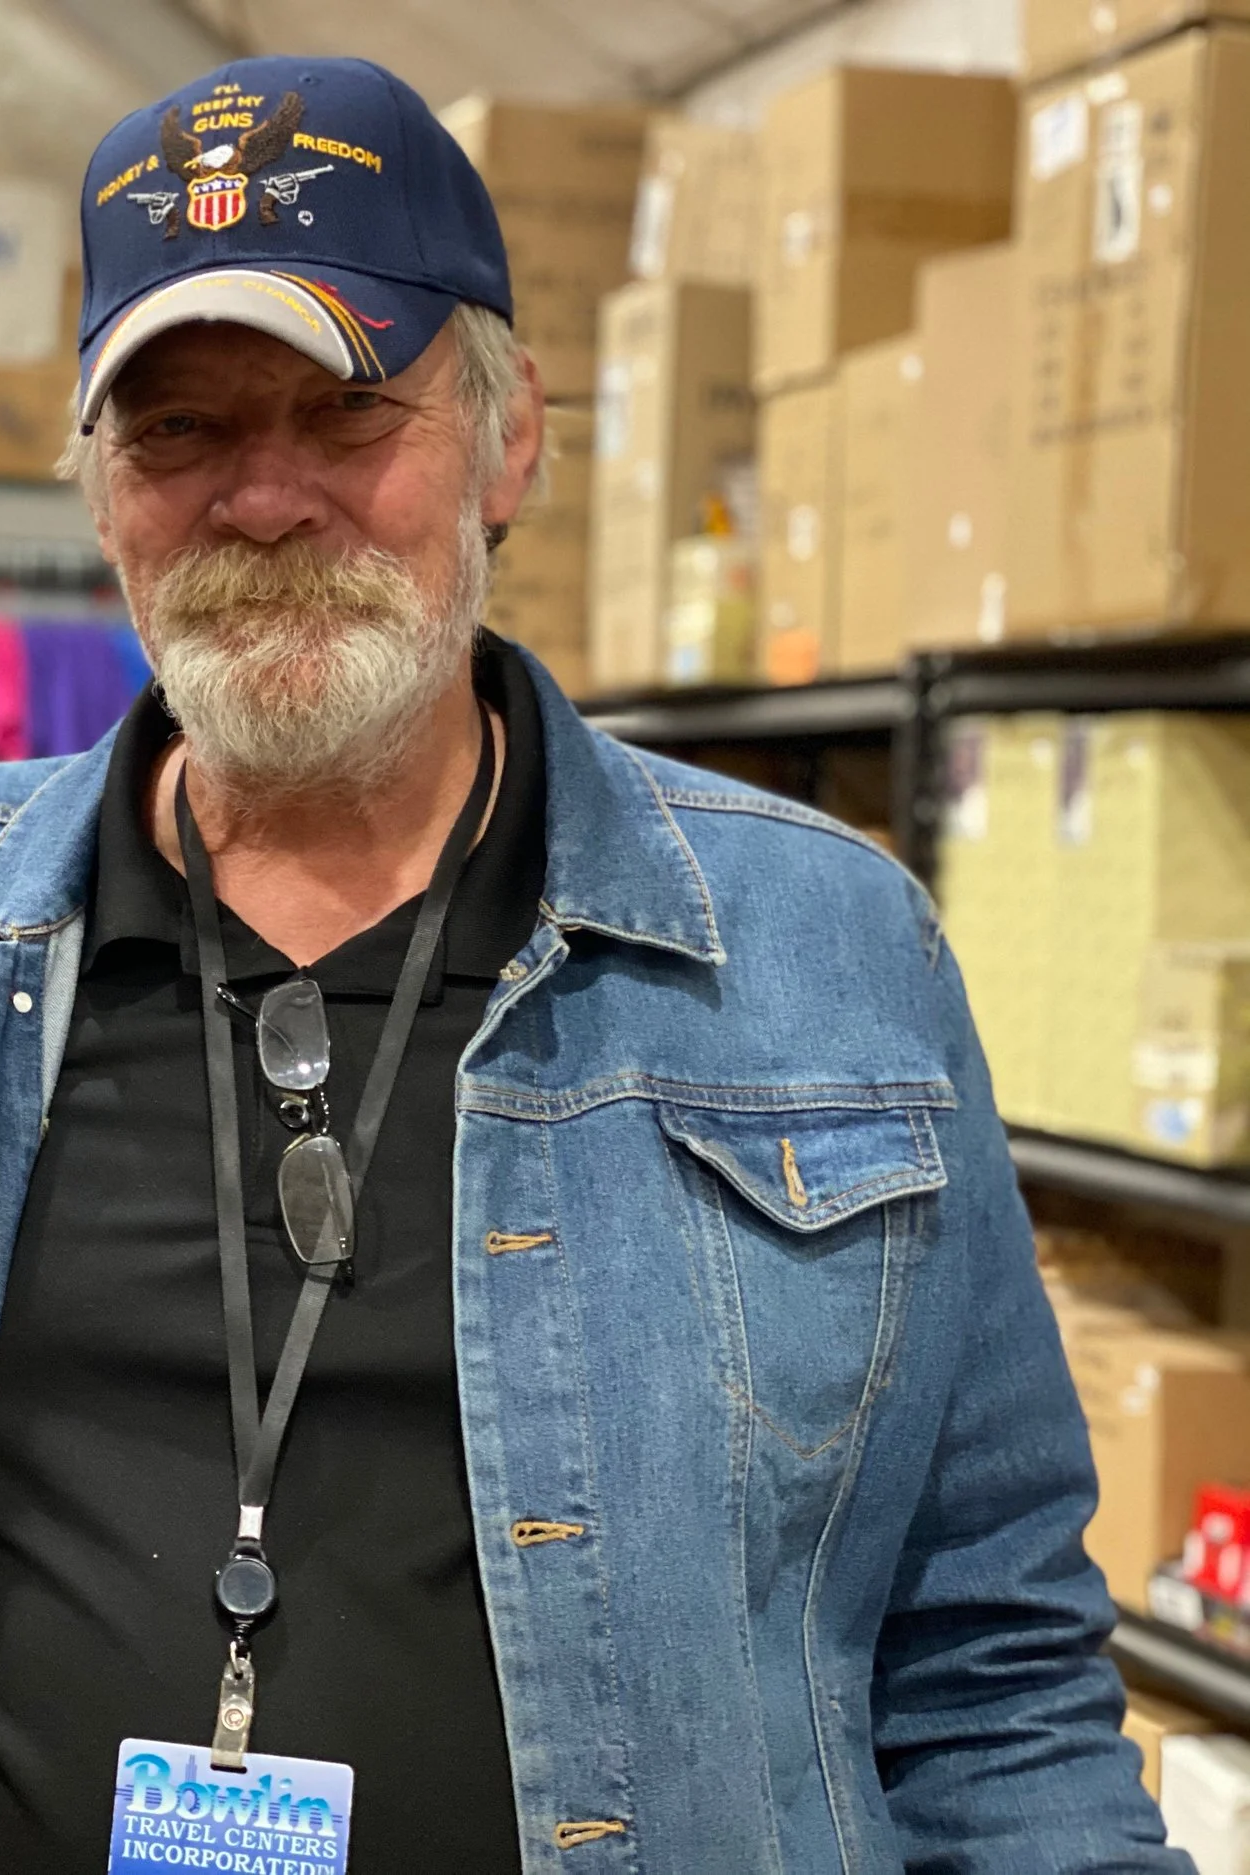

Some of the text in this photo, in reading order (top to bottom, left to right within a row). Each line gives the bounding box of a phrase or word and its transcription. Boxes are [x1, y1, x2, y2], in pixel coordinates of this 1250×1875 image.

[237, 96, 264, 108] MY
[193, 112, 254, 133] GUNS
[146, 154, 159, 171] &
[293, 132, 382, 174] FREEDOM
[125, 1753, 338, 1838] Bowlin
[124, 1815, 338, 1859] TRAVEL CENTERS
[122, 1839, 316, 1875] INCORPORATED
